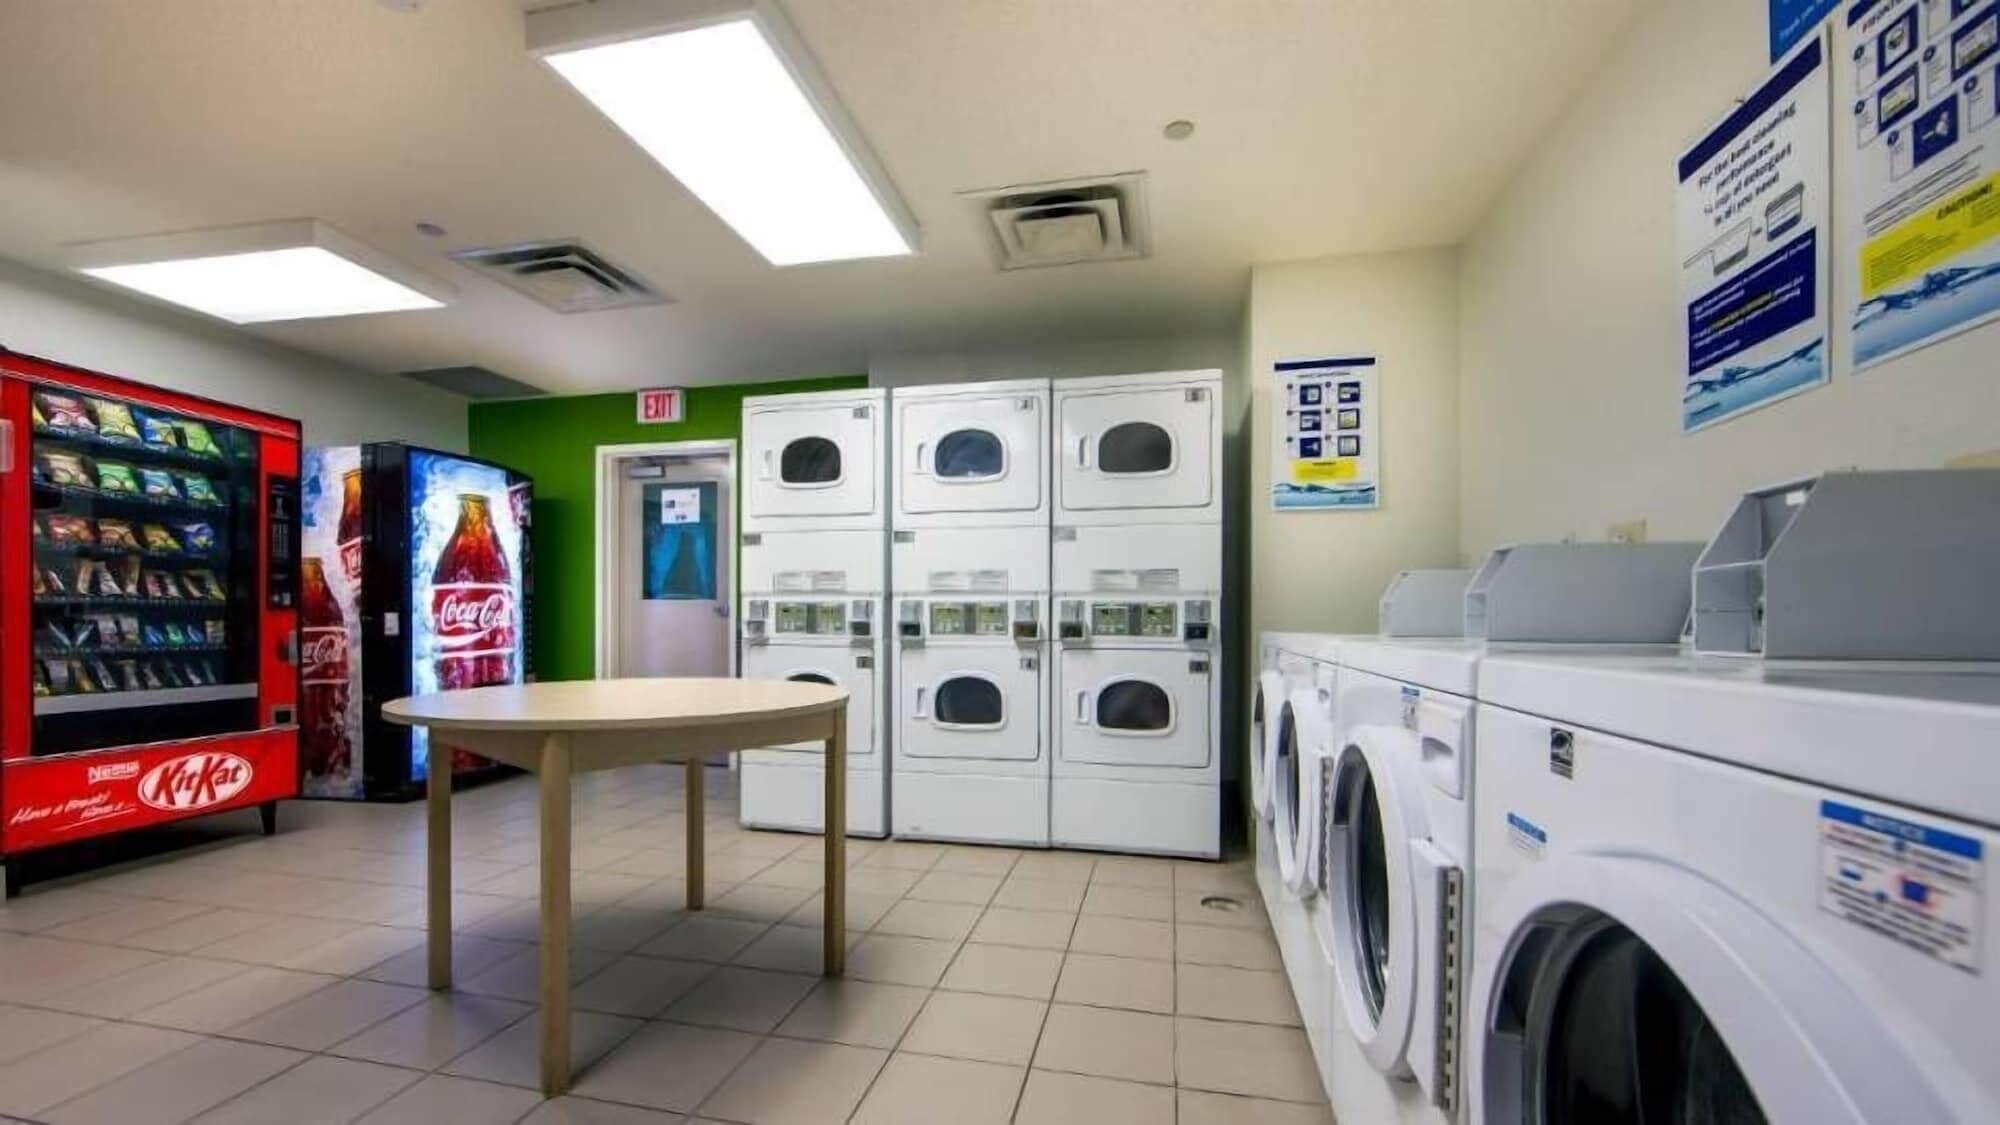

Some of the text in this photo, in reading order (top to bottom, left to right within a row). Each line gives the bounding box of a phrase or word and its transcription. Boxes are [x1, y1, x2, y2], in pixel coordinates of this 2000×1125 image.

[1699, 100, 1797, 189] For the best cleaning
[1716, 139, 1775, 194] performance
[1743, 141, 1791, 188] detergent
[644, 393, 673, 419] EXIT
[150, 755, 244, 807] KitKat
[9, 806, 52, 826] Have
